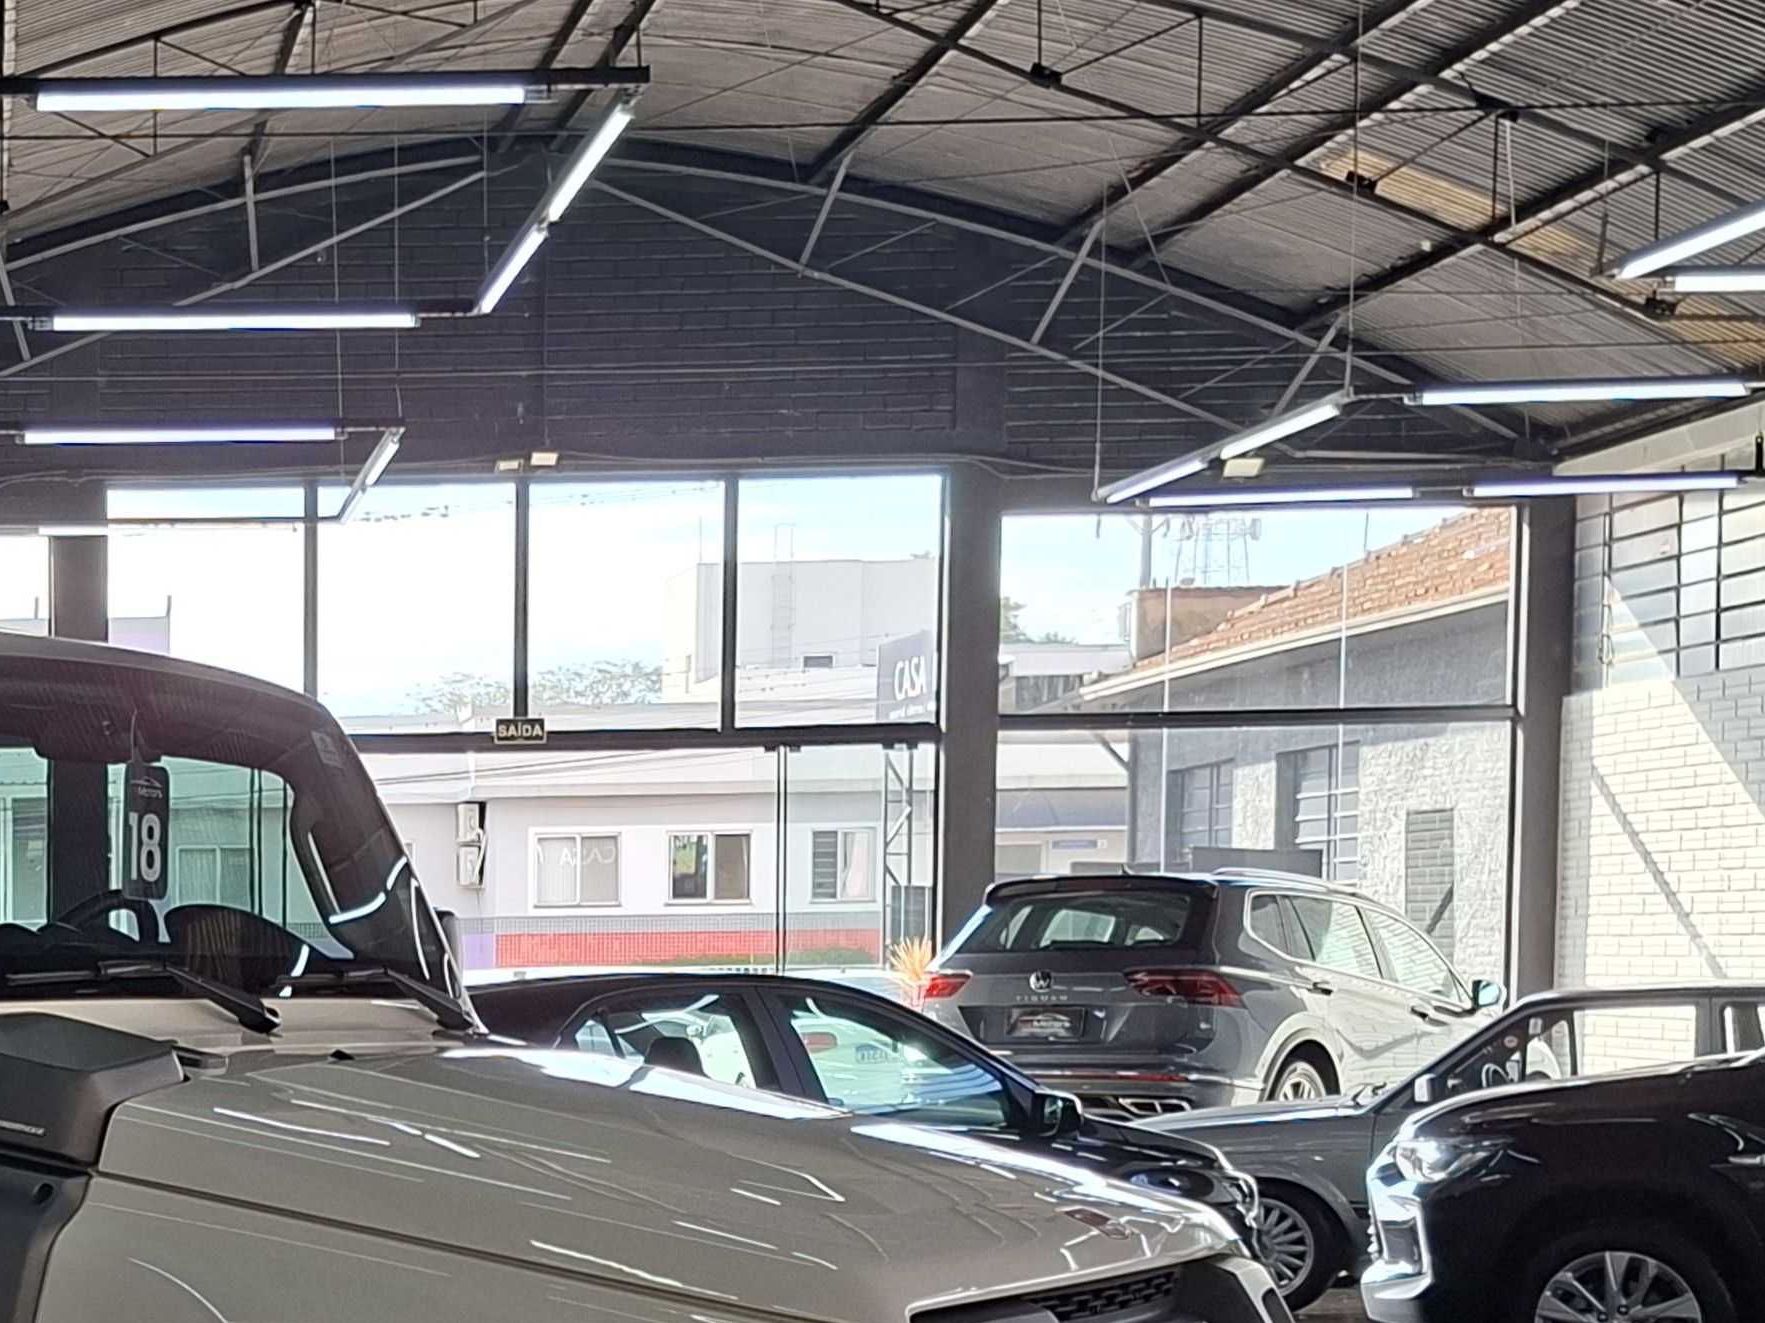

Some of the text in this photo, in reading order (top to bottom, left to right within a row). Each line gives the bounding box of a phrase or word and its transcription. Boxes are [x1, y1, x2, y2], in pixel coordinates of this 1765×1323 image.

[894, 656, 927, 701] CASA
[498, 722, 543, 737] SAÍDA
[129, 811, 162, 882] 18
